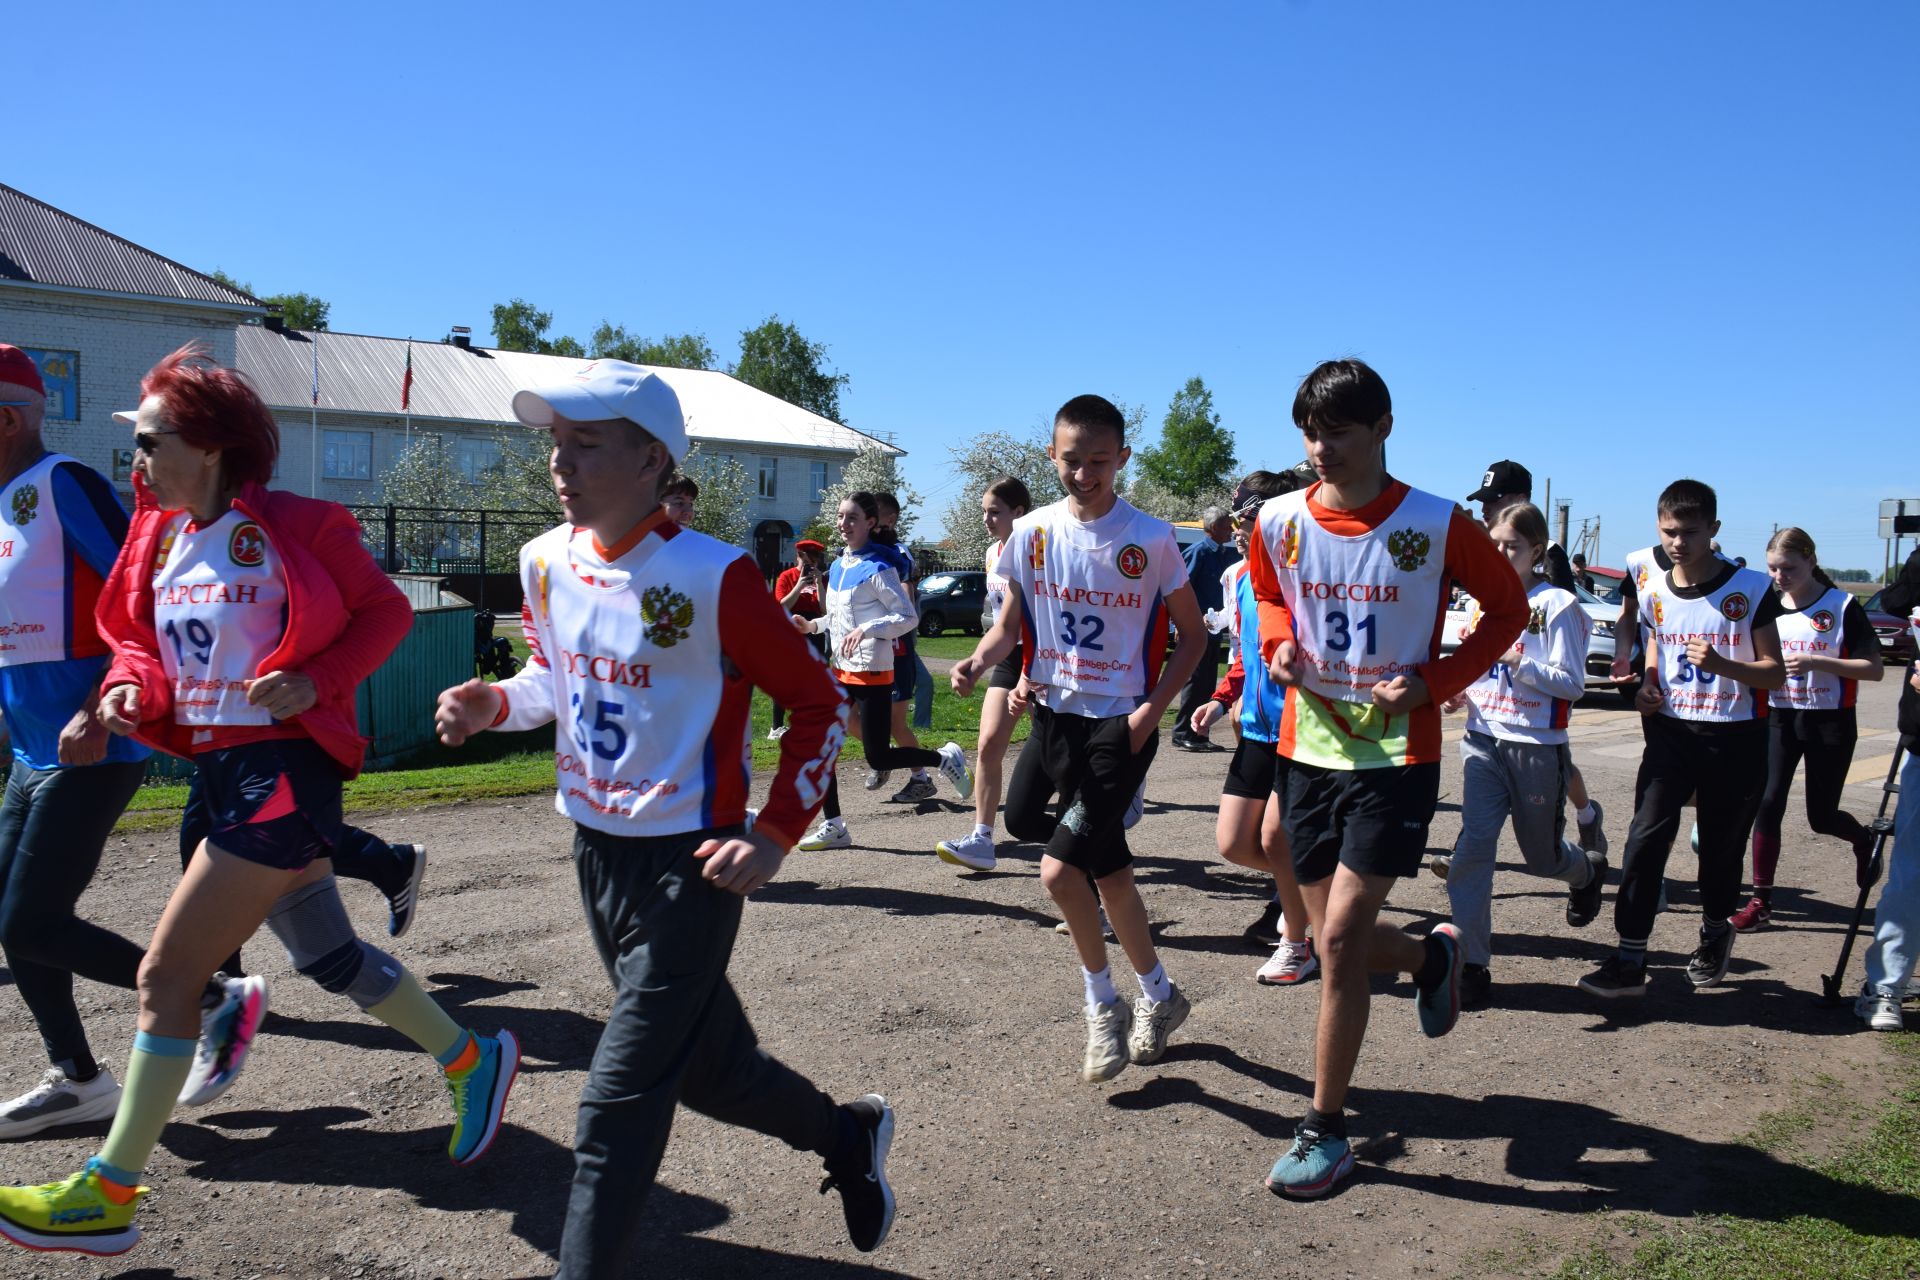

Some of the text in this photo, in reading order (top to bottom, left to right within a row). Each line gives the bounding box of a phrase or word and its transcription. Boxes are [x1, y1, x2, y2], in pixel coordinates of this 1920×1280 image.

[1035, 580, 1142, 608] ТТАРСТАН
[1301, 582, 1400, 602] РОССИЯ
[165, 618, 214, 667] 19
[1060, 611, 1105, 651] 32
[1325, 610, 1377, 655] 31
